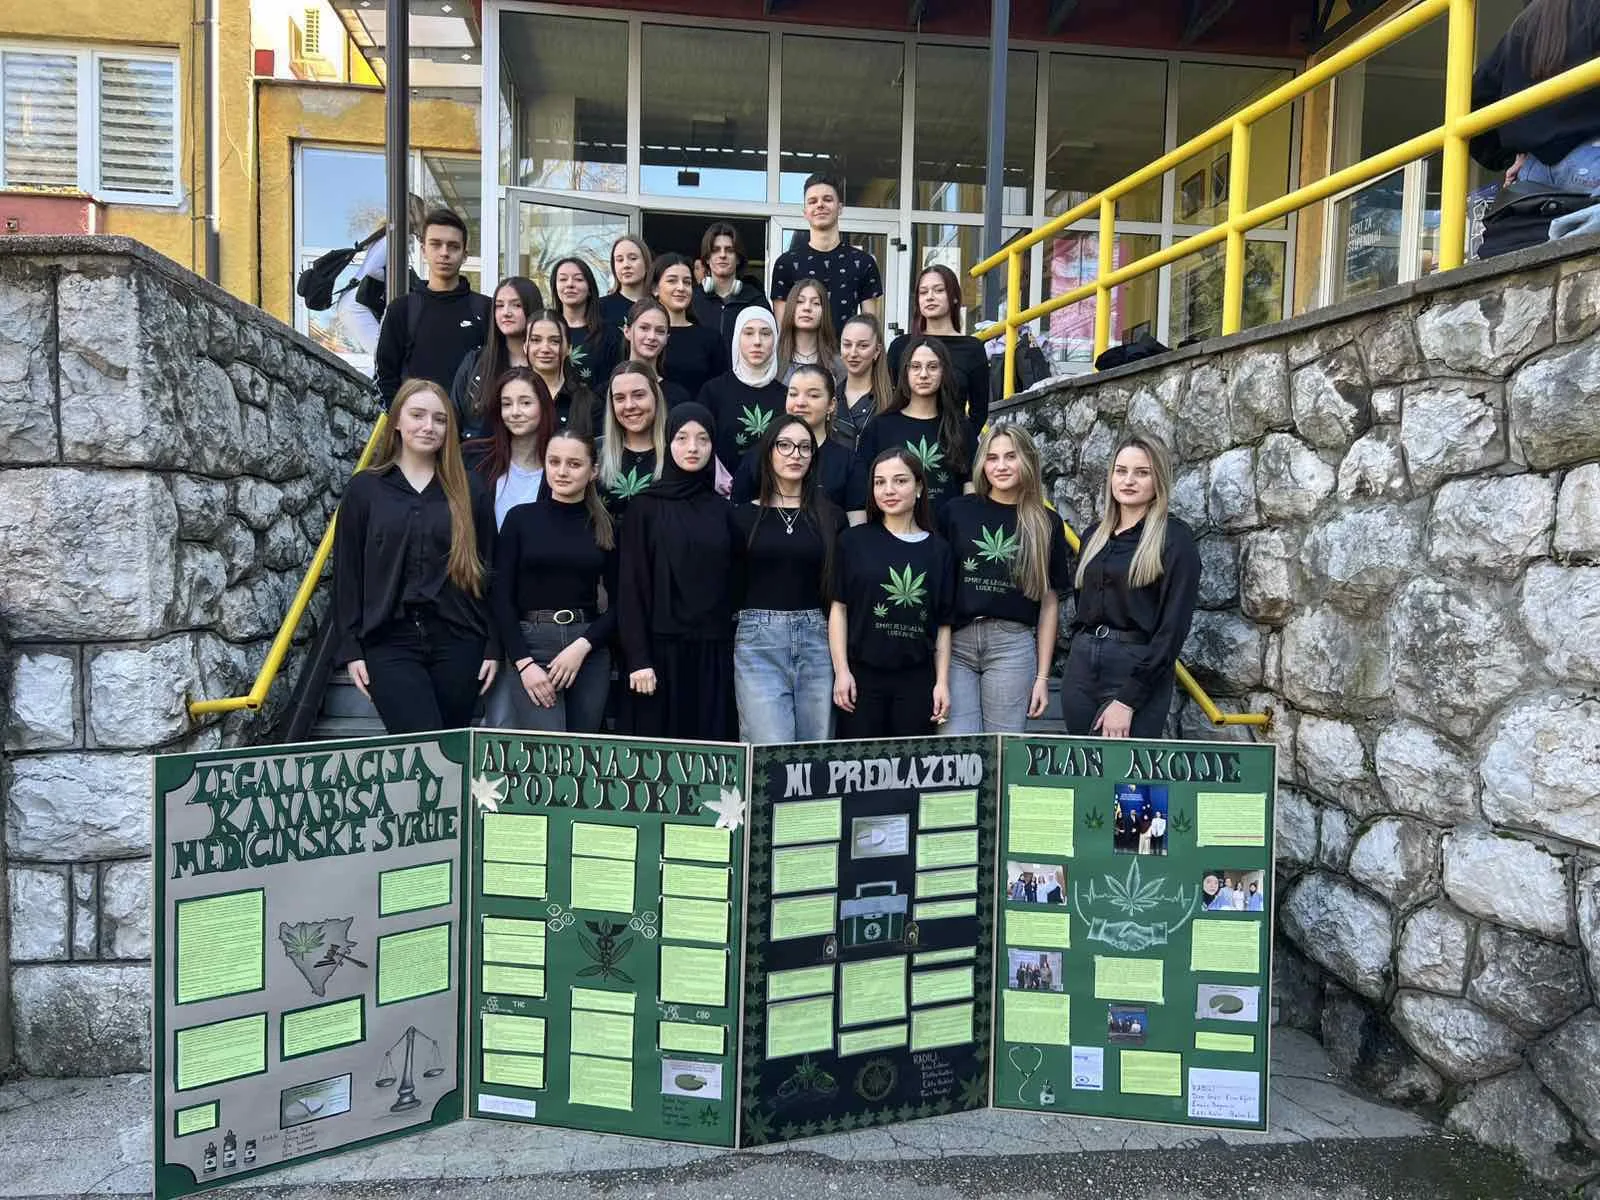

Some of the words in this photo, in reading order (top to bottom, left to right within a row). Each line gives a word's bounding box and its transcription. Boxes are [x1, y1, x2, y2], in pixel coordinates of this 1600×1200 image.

[185, 746, 436, 804] LEGALIZACIJA
[481, 740, 738, 785] ALTERNATIVNE
[784, 763, 812, 798] MI
[1024, 744, 1104, 777] PLAN
[1124, 749, 1241, 783] AKCIJE
[205, 782, 393, 840] KANABISA
[416, 776, 443, 810] U
[500, 773, 702, 816] POLITIKE
[171, 819, 366, 879] MEDICINSKE
[373, 806, 458, 851] SVRHE
